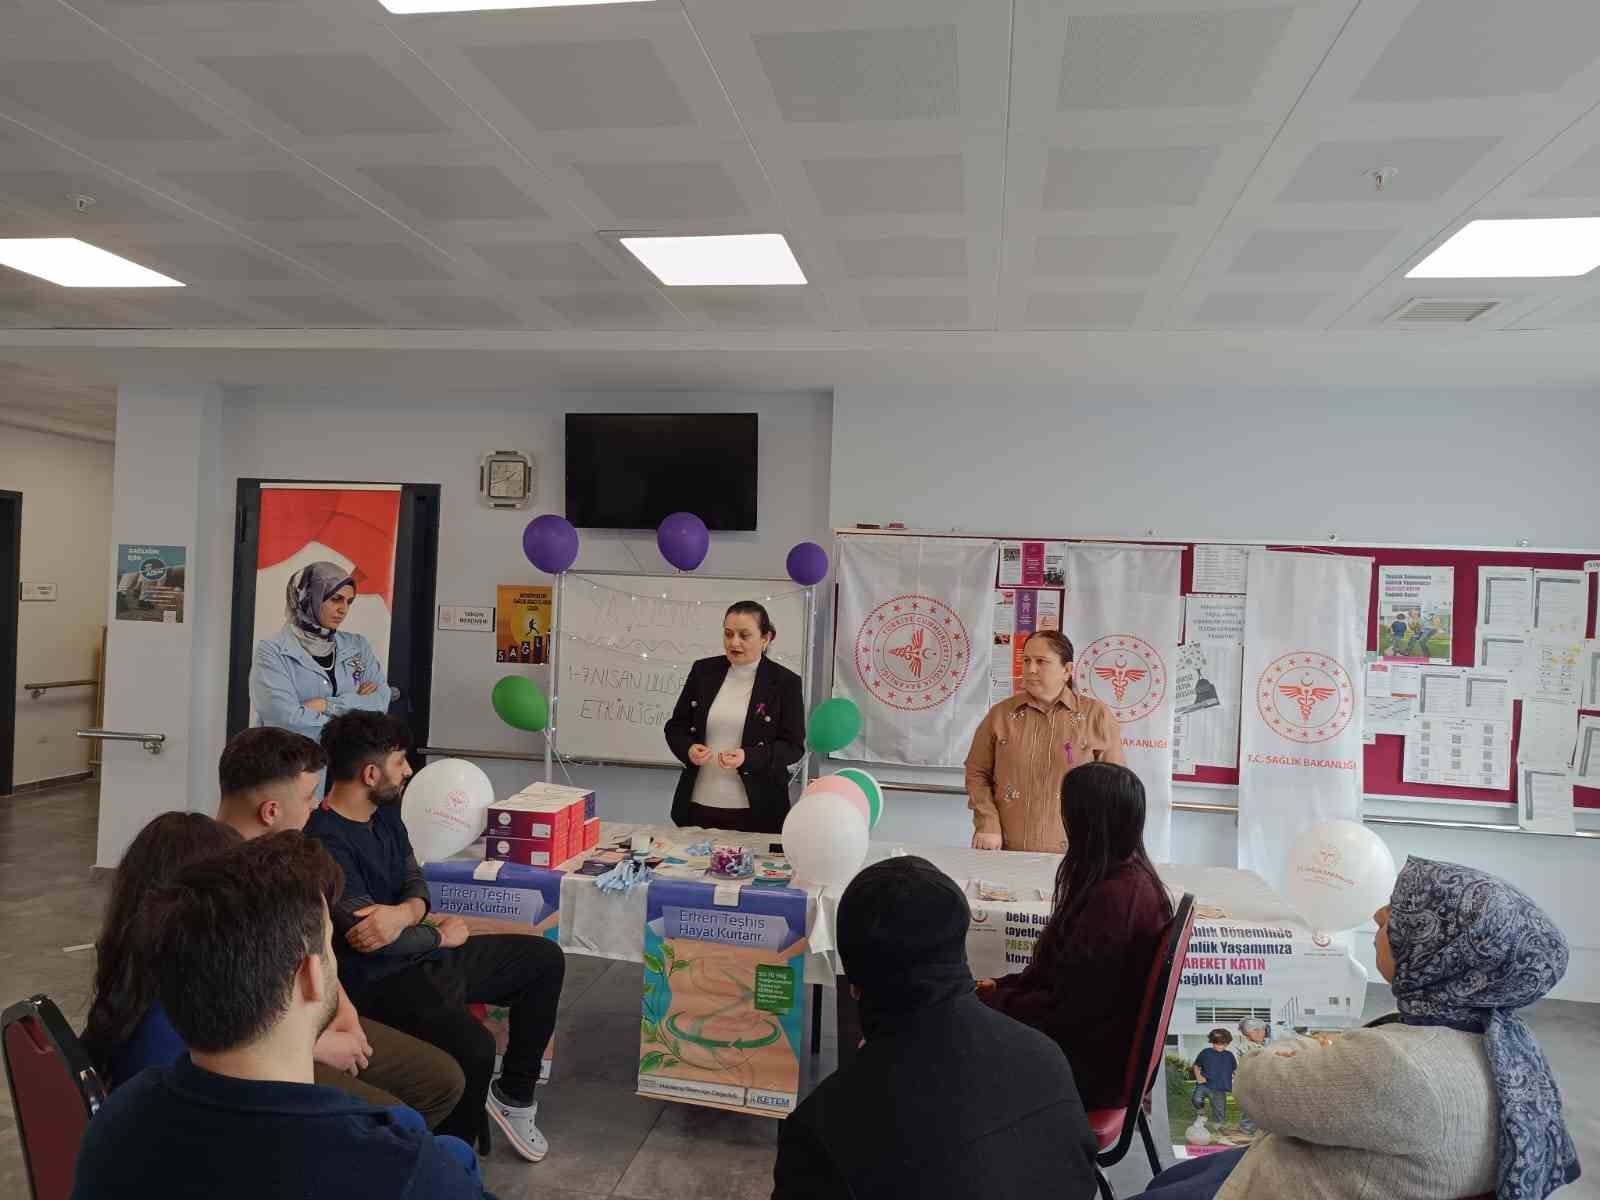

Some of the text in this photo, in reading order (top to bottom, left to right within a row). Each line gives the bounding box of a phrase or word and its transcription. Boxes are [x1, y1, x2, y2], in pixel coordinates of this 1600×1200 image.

[440, 885, 521, 903] Erken Teşhis
[440, 898, 474, 912] Hayat
[680, 909, 765, 930] Erken Teşhis
[680, 924, 714, 938] Hayat
[1221, 941, 1293, 956] Yaşamınıza
[1183, 957, 1265, 970] AREKET KATIN
[1226, 973, 1263, 986] Kalın!
